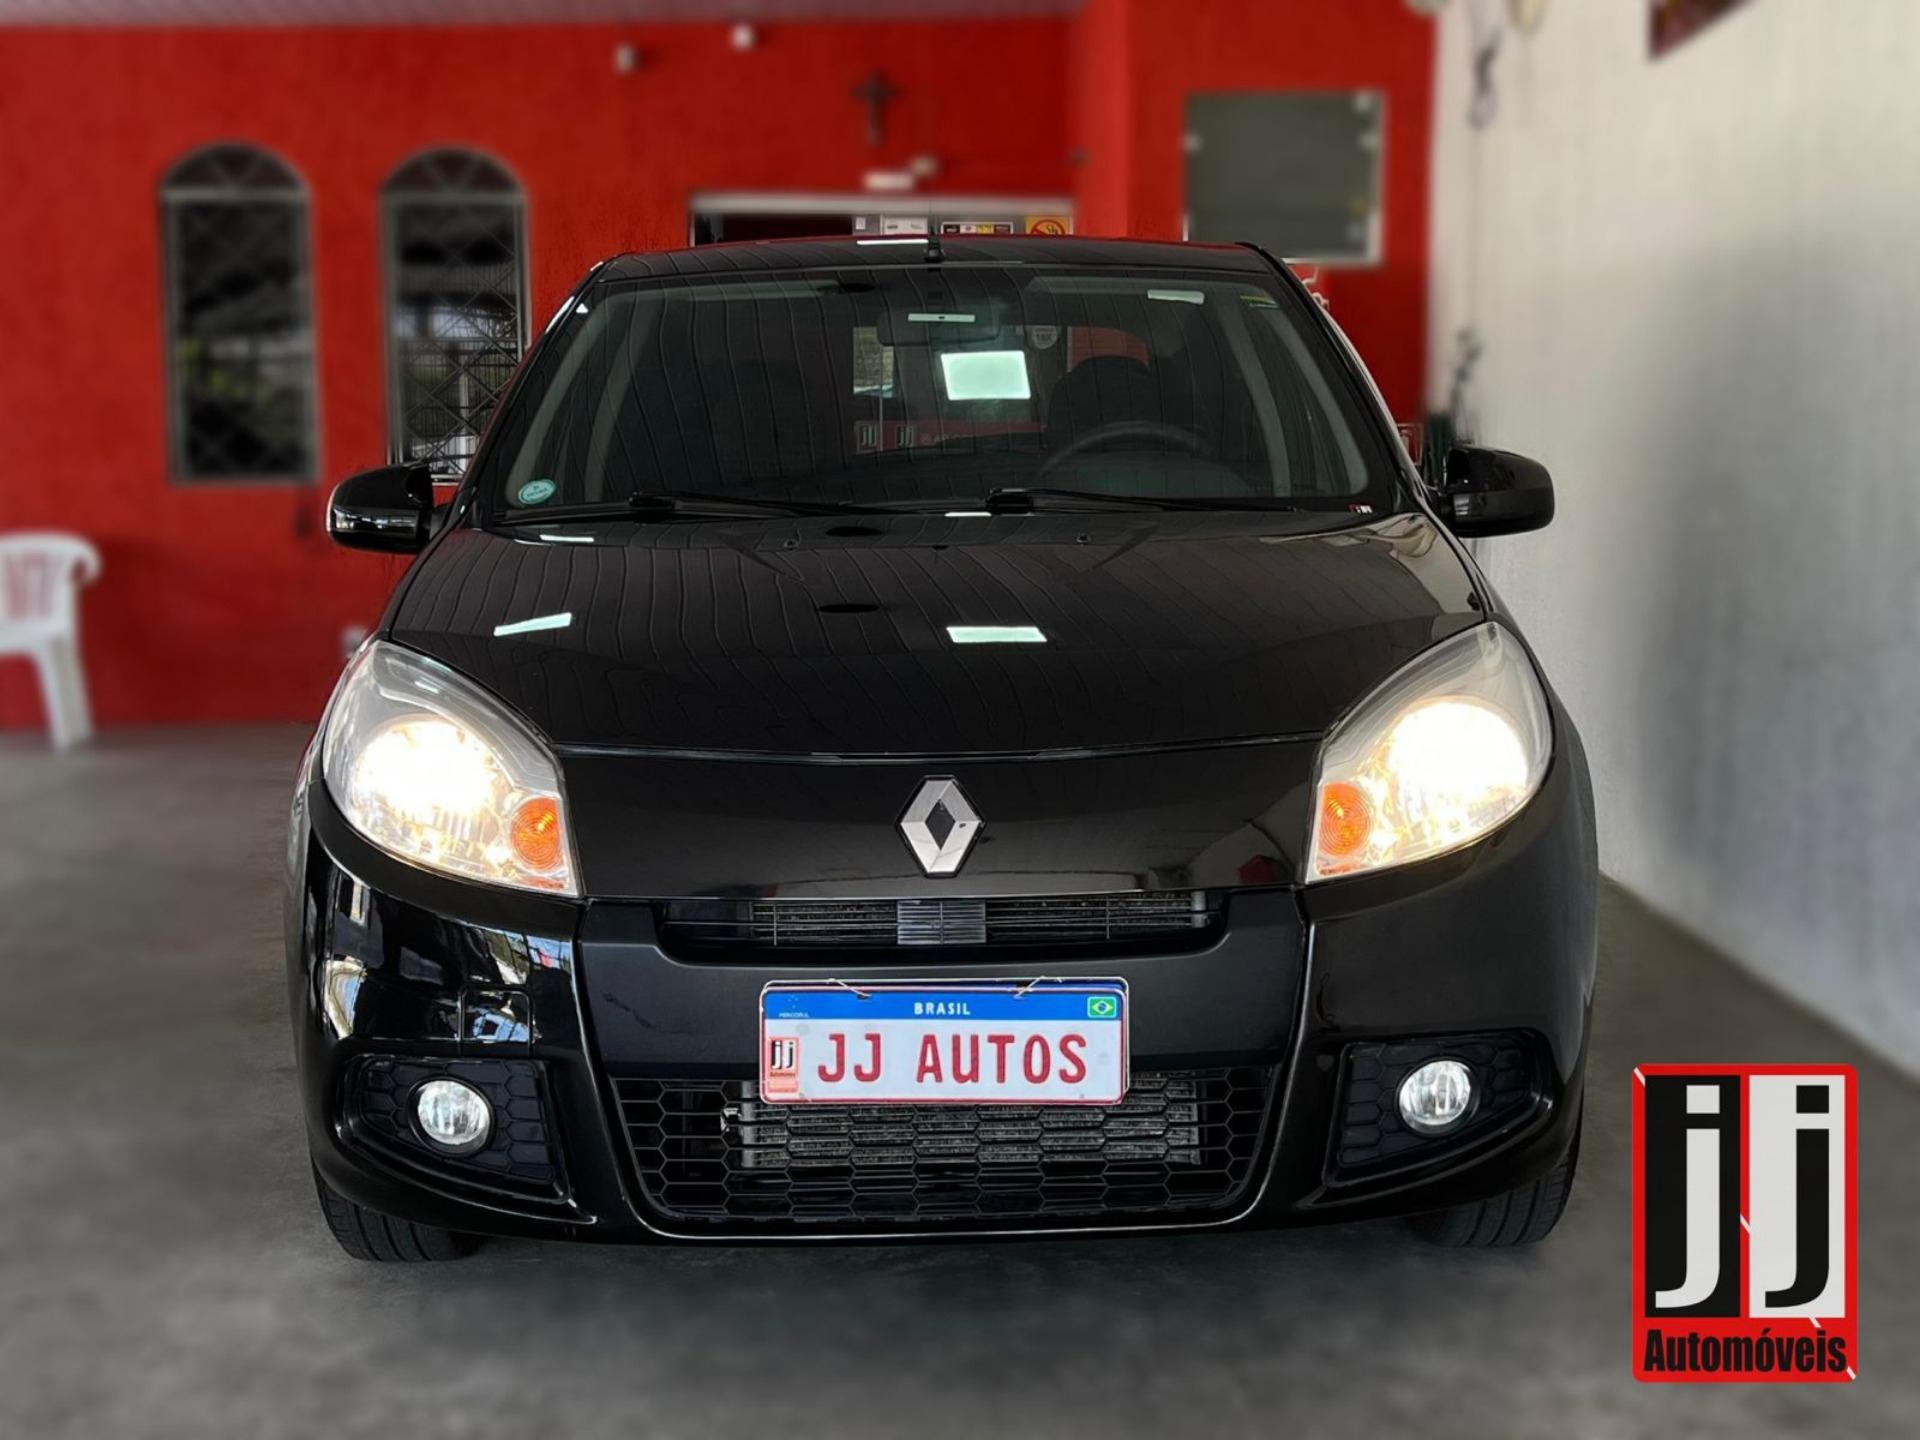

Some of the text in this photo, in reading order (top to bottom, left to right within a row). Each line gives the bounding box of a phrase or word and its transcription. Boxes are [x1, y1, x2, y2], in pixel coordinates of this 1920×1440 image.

[914, 1001, 971, 1016] BRASIL
[817, 1033, 1088, 1084] JJ AUTOS
